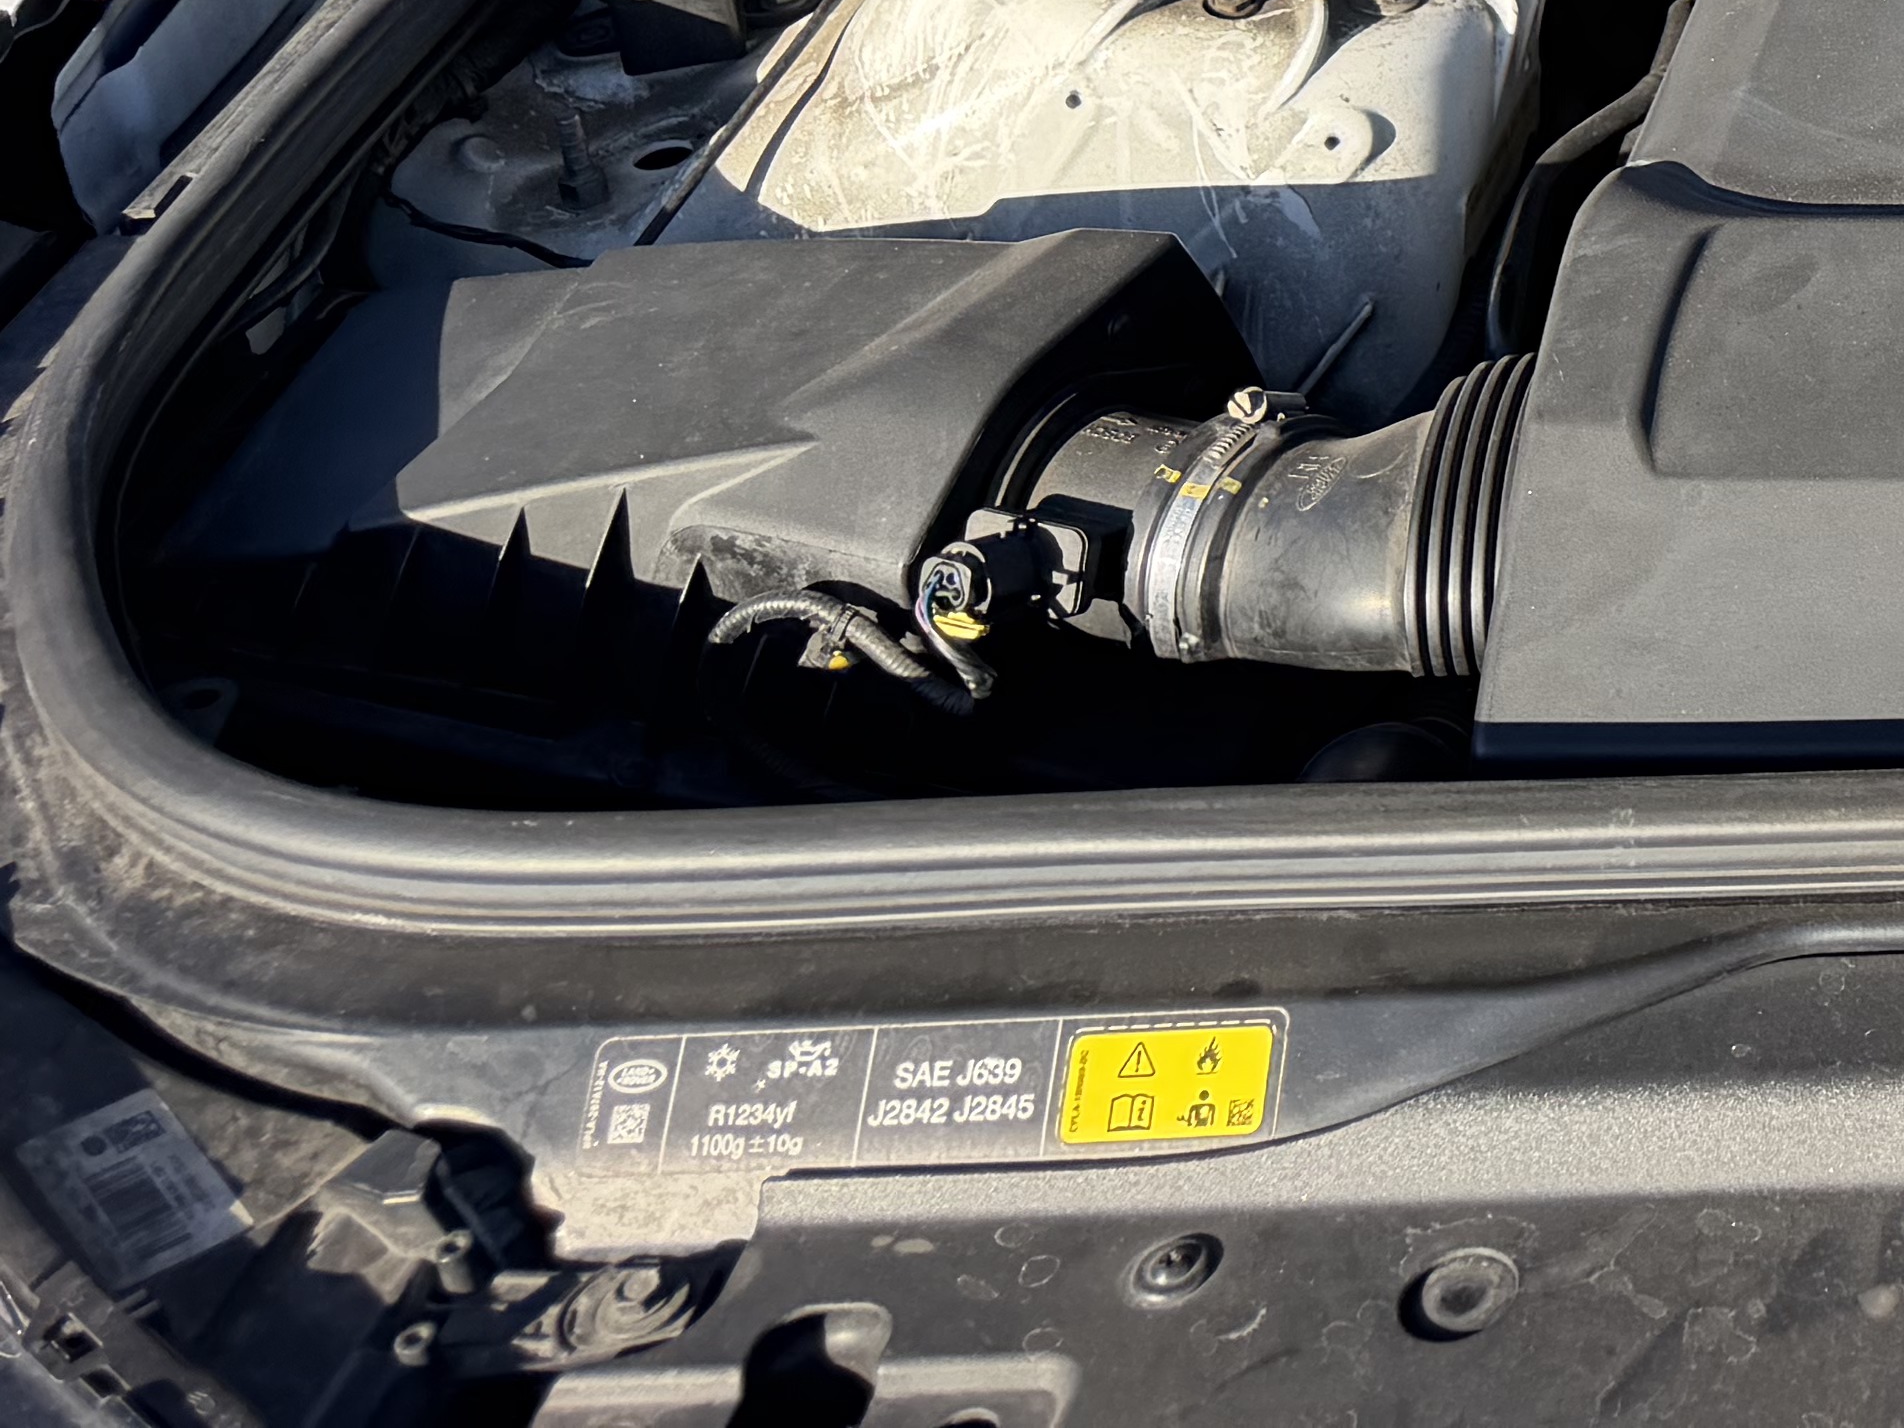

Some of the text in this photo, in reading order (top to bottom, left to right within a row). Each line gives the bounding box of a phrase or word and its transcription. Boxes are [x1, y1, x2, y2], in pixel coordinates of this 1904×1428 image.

[895, 1058, 1022, 1088] SAE J639
[709, 1101, 797, 1129] R1234yf
[868, 1093, 1036, 1126] J2842 J2845
[691, 1135, 745, 1158] 1100g
